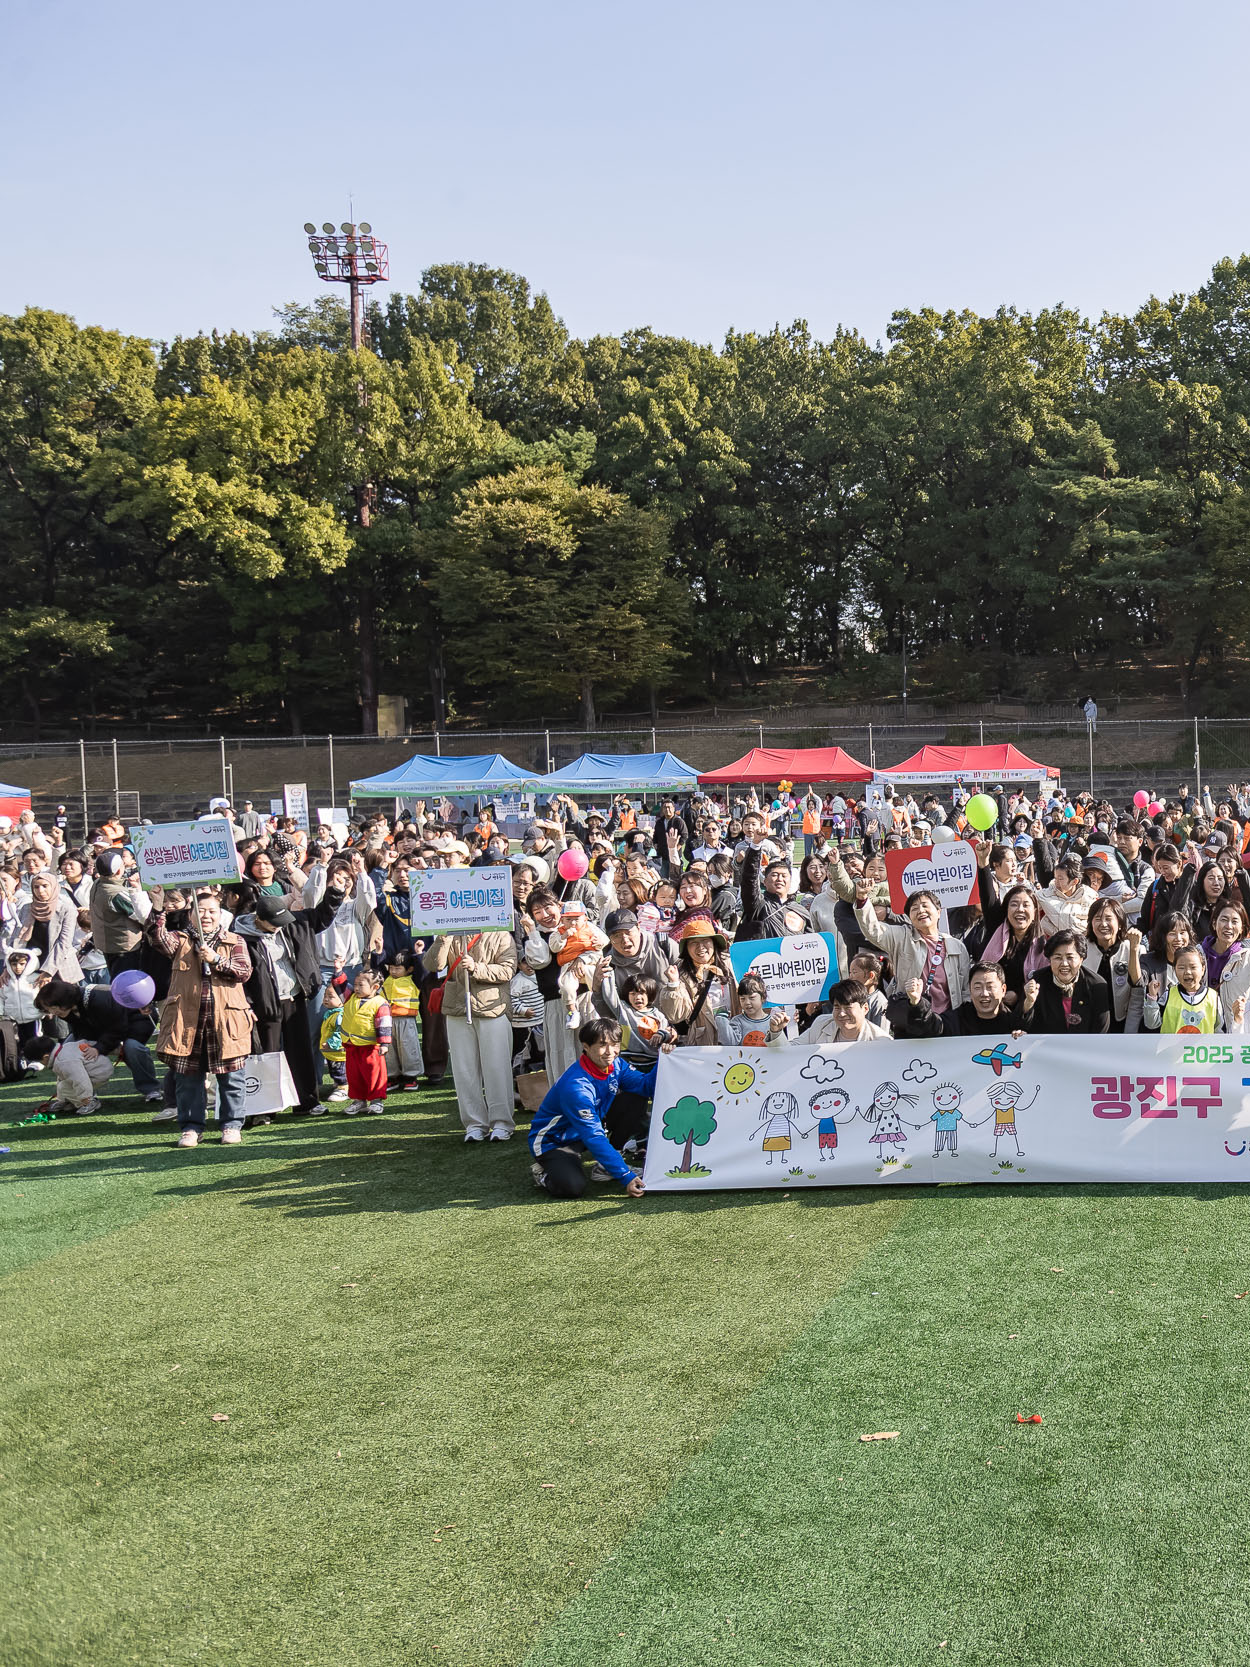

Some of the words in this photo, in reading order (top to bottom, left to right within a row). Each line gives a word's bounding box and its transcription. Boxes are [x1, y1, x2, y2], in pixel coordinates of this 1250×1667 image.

[143, 841, 230, 867] 상상놀이터어린이집
[903, 864, 973, 886] 해든어린이집
[419, 891, 447, 911] 용곡
[450, 888, 506, 910] 어린이집
[765, 978, 822, 991] 진구민간어린이집연합회
[1183, 1046, 1233, 1064] 2025
[1091, 1076, 1222, 1119] 광진구
